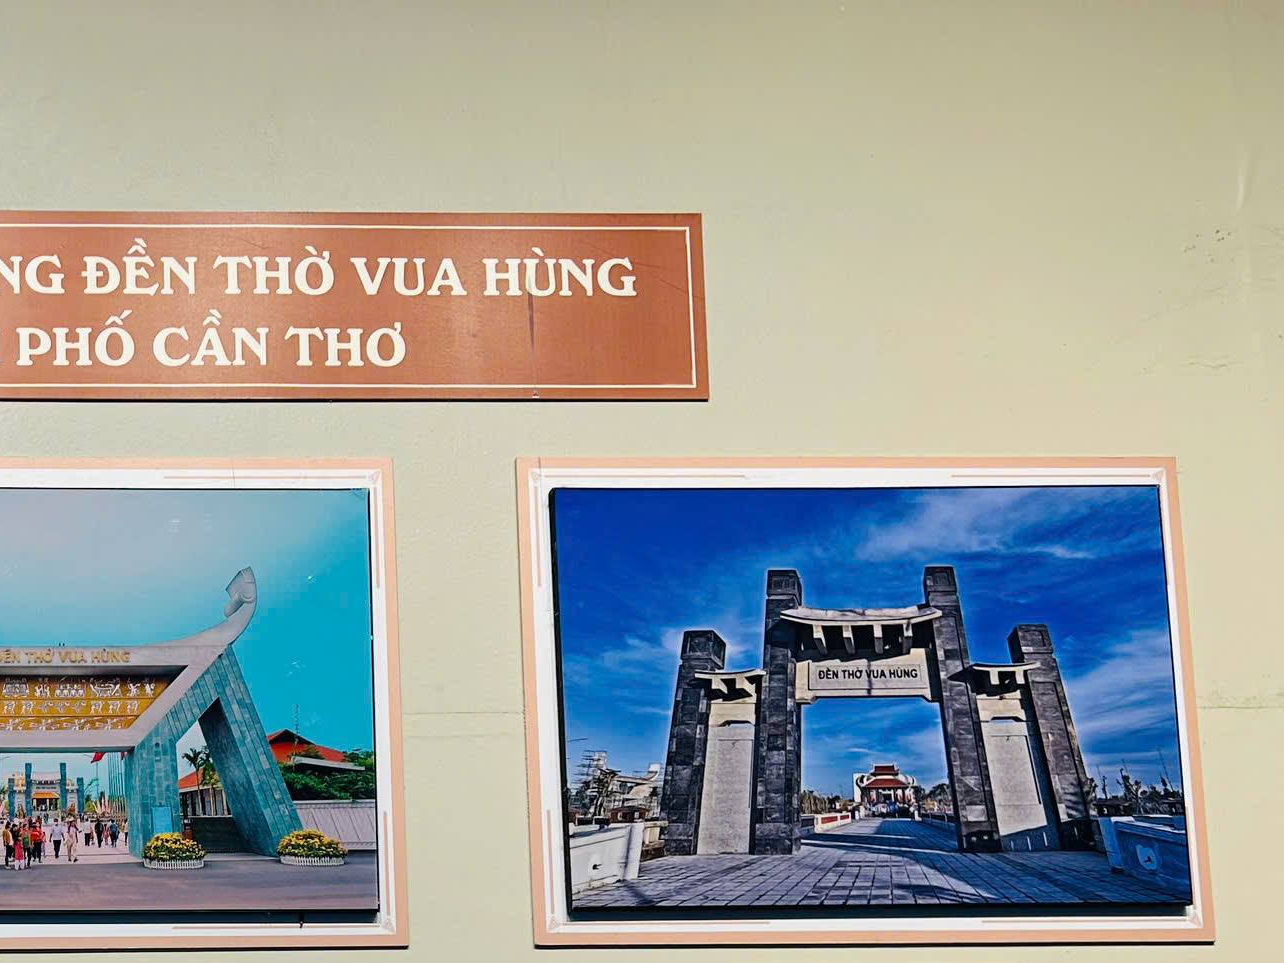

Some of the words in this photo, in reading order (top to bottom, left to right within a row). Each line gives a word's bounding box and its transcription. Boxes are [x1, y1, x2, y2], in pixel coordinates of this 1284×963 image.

[82, 239, 197, 295] ĐỀN
[213, 246, 333, 295] THỜ
[351, 258, 466, 295] VUA
[483, 248, 636, 296] HÙNG
[17, 310, 134, 365] PHỐ
[153, 310, 268, 366] CẦN
[285, 323, 405, 366] THƠ
[58, 651, 87, 663] VUA
[841, 667, 863, 679] THỜ
[865, 669, 887, 679] VUA
[889, 666, 918, 679] HÙNG
